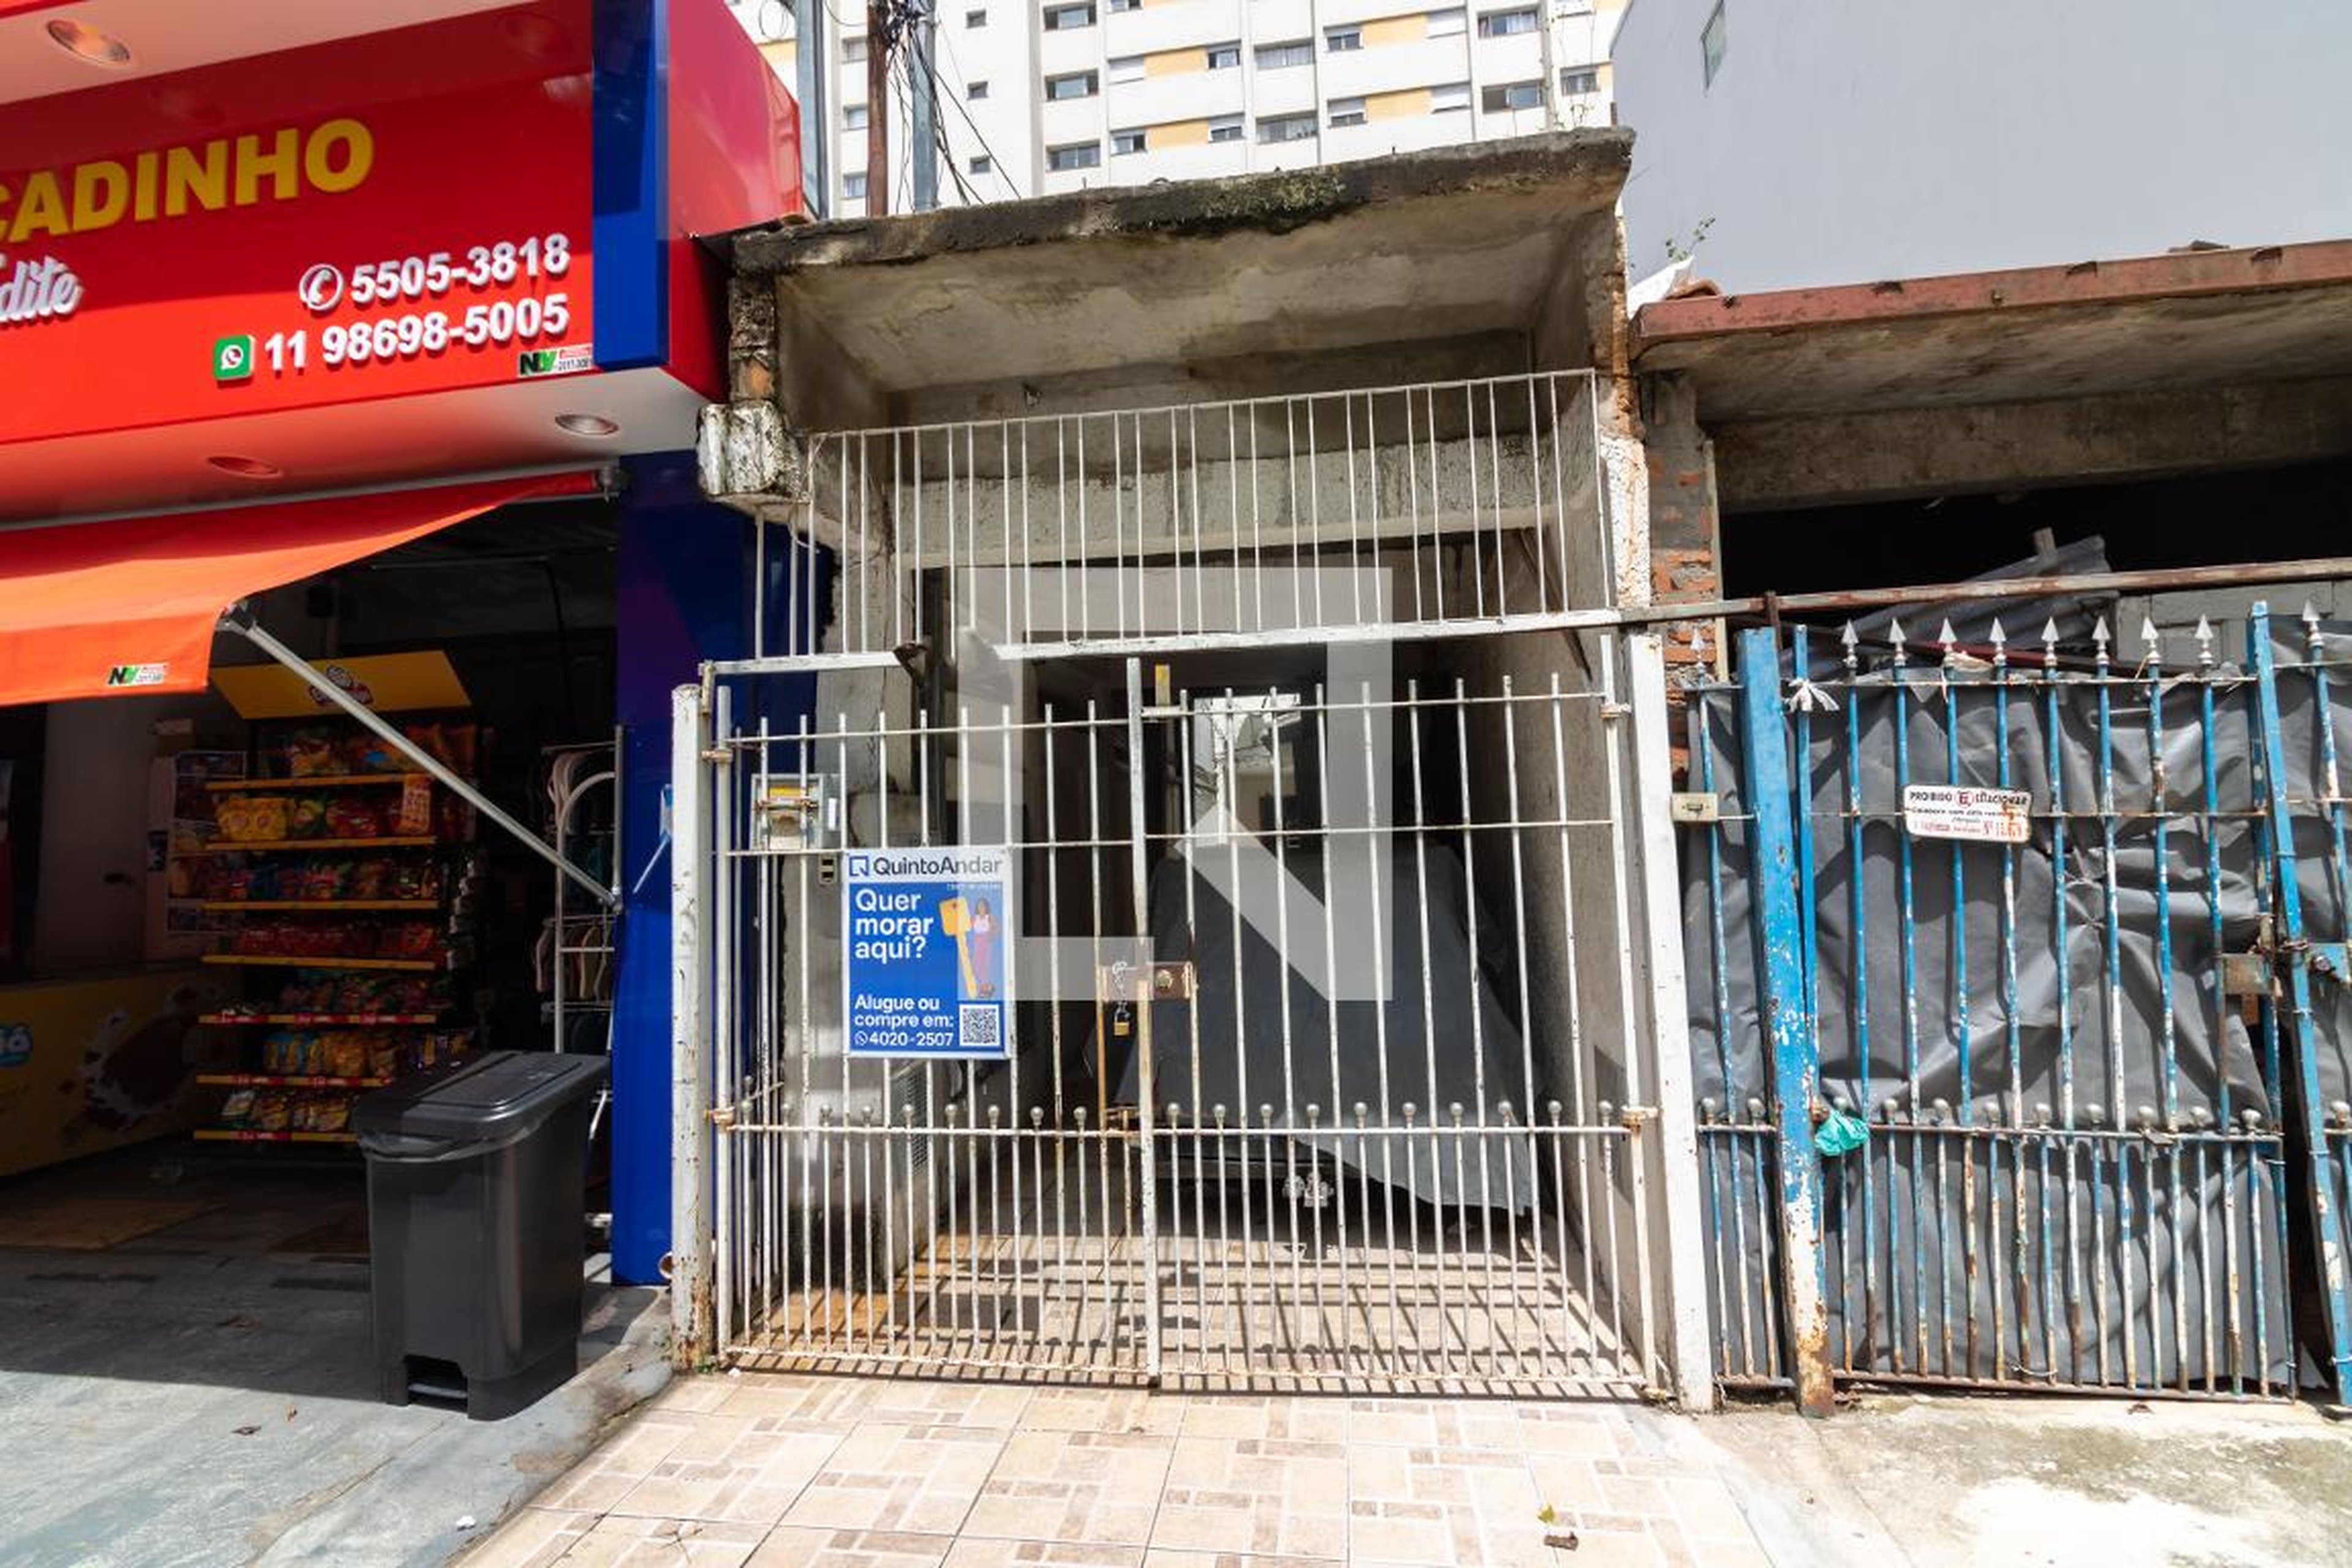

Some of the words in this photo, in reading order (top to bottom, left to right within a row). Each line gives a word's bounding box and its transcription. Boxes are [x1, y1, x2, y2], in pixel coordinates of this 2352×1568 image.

[0, 119, 374, 243] ADINHO
[351, 233, 570, 304] 5505-3818
[0, 252, 85, 323] dite
[265, 330, 306, 371] 11
[322, 293, 569, 364] 98698-5005
[873, 856, 1003, 875] QuintoAndar
[855, 888, 921, 911] Quer
[855, 918, 933, 935] morar
[855, 936, 926, 964] aqui?
[854, 995, 914, 1012] Alugue
[918, 998, 940, 1010] ou
[854, 1015, 919, 1030] compre
[922, 1016, 954, 1027] em:
[870, 1032, 954, 1046] 4020-2507
